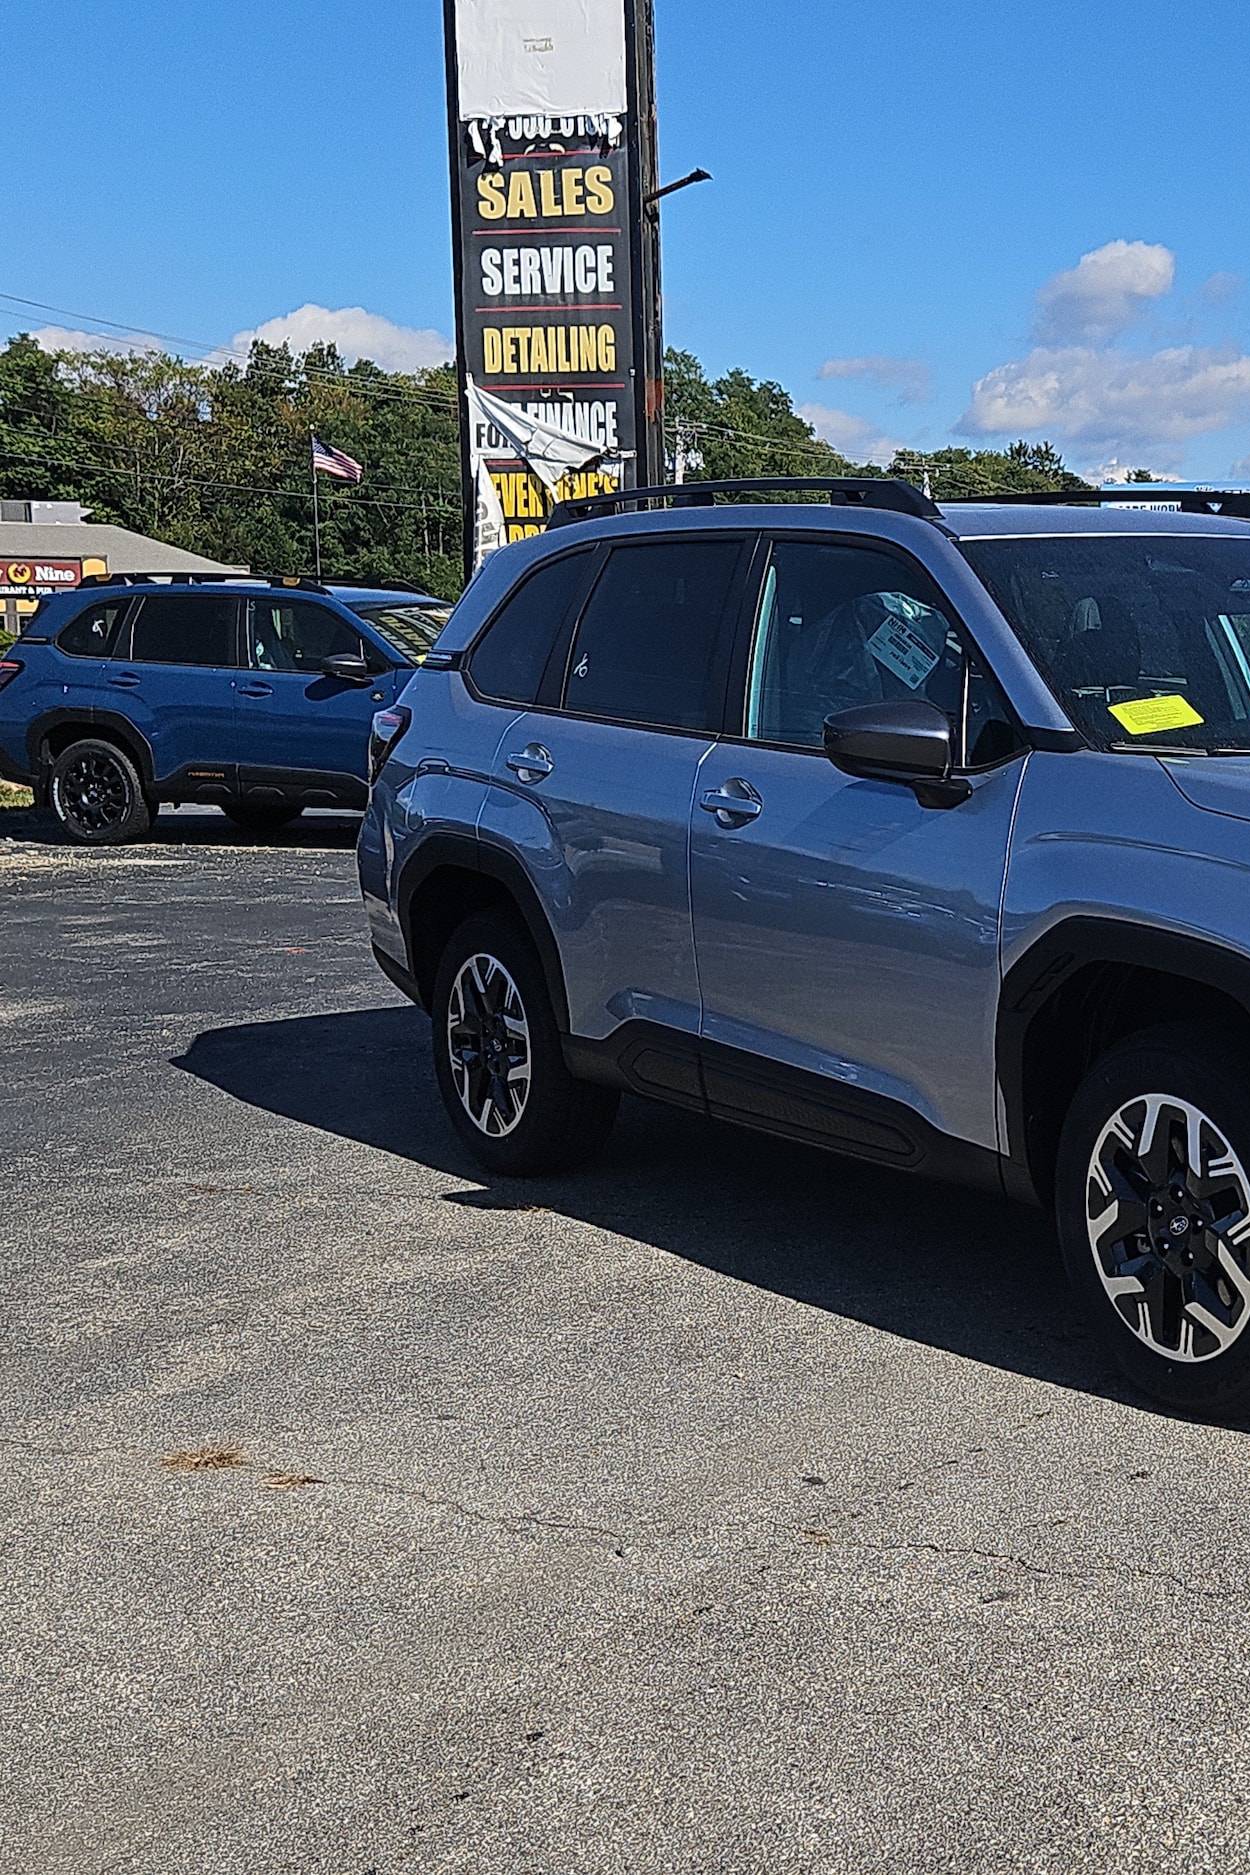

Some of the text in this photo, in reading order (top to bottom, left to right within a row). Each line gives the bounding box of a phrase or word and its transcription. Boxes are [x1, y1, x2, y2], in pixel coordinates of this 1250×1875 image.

[477, 166, 614, 219] SALES
[481, 245, 614, 295] SERVICE
[483, 324, 615, 373] DETAILING
[35, 565, 75, 582] Nine
